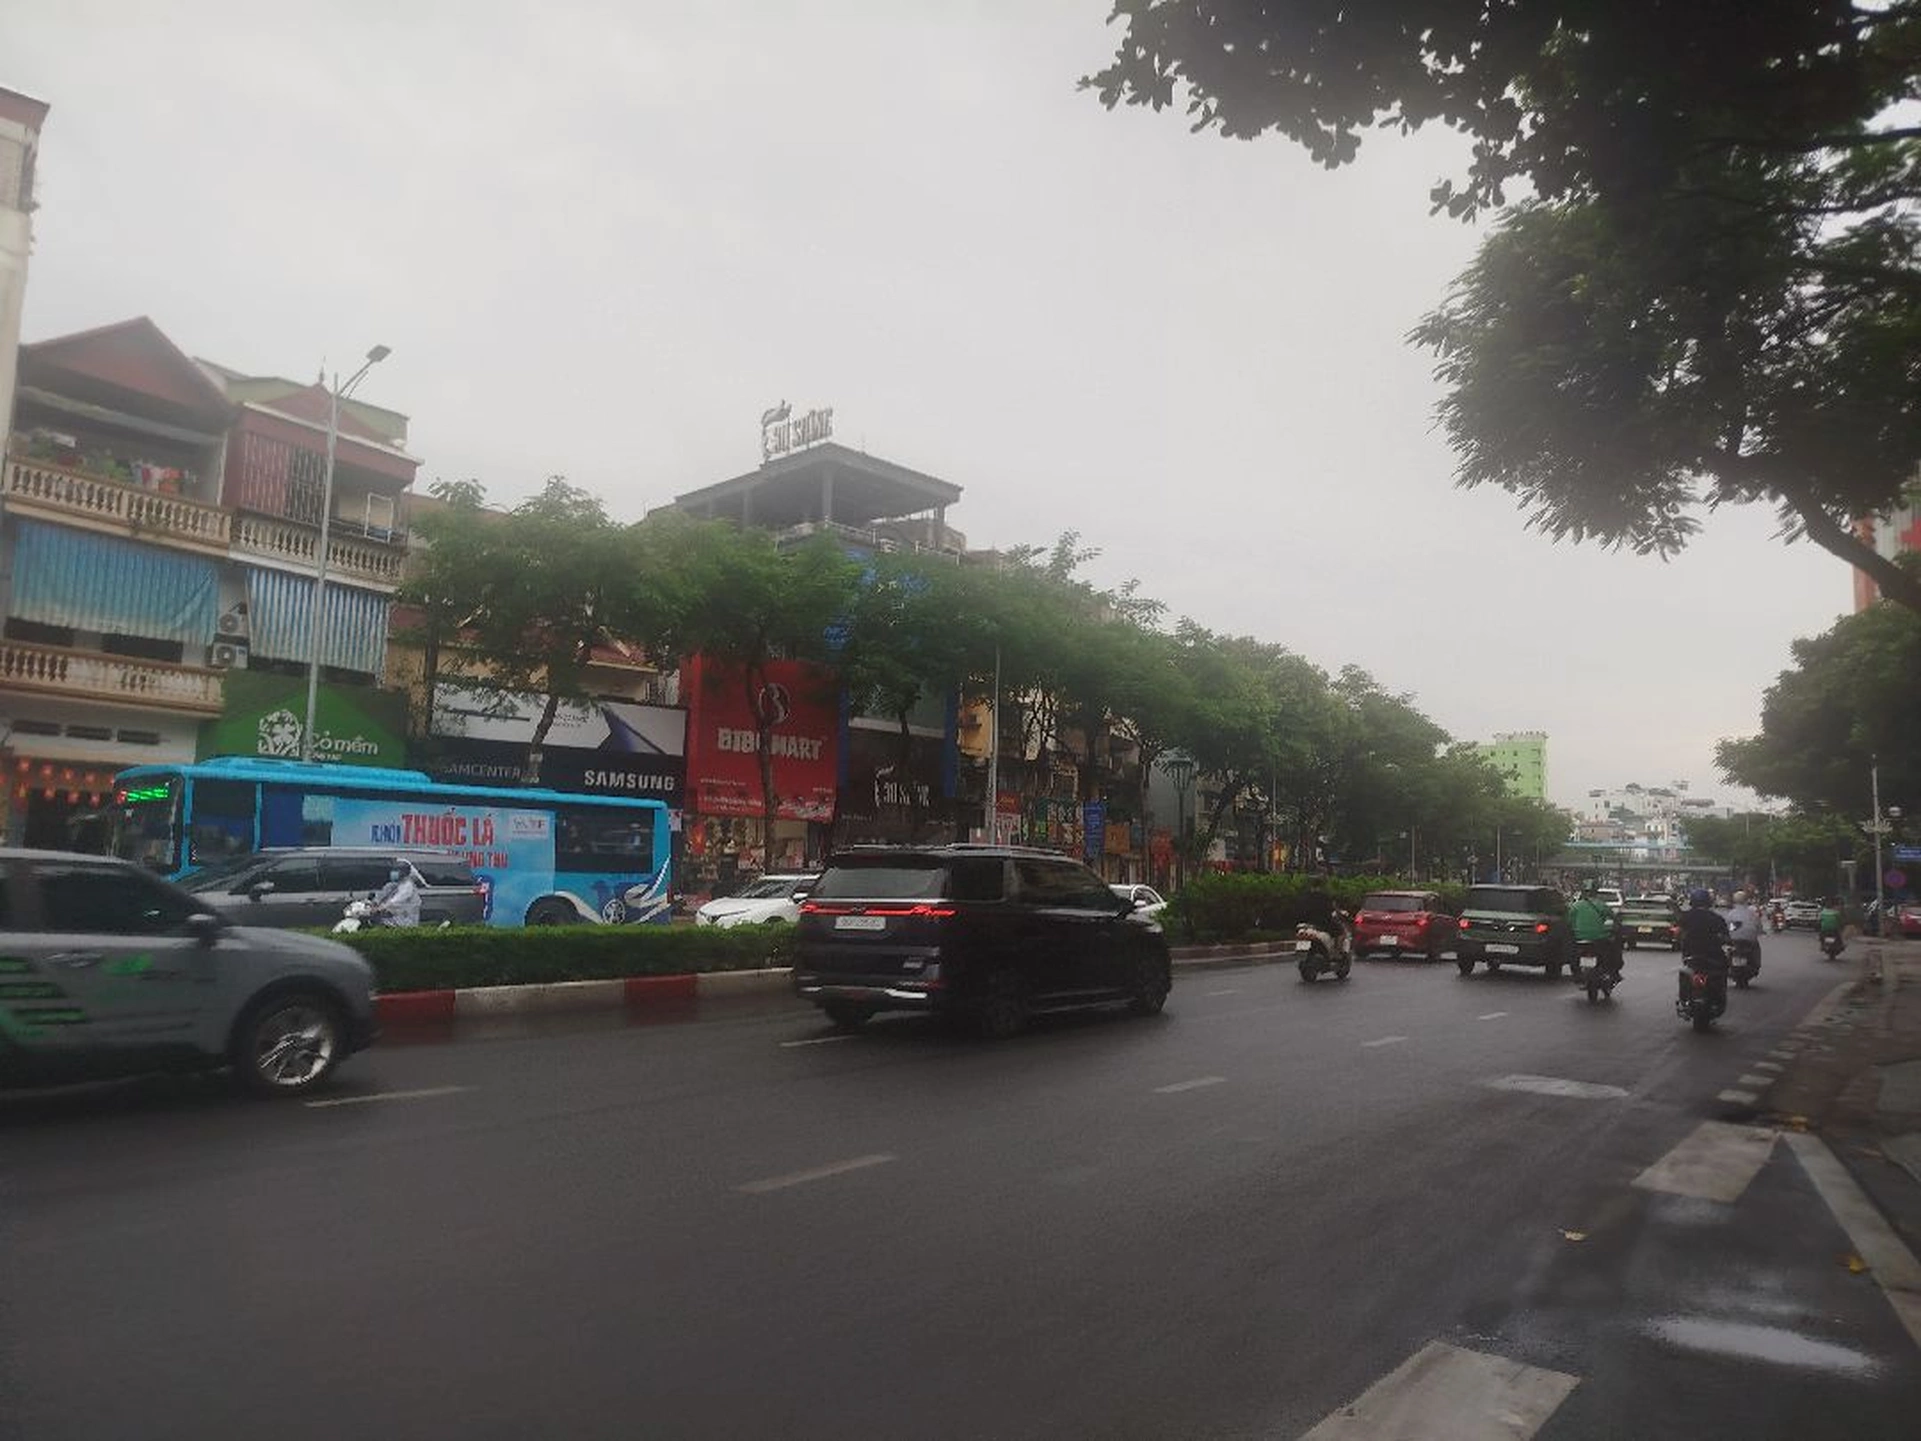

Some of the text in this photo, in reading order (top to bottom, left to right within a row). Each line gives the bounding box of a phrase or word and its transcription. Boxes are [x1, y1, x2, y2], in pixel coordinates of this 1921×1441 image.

[718, 727, 823, 760] BIB MART
[584, 769, 675, 791] SAMSUNG
[402, 807, 467, 847] THUỐC
[473, 813, 494, 847] LÁ
